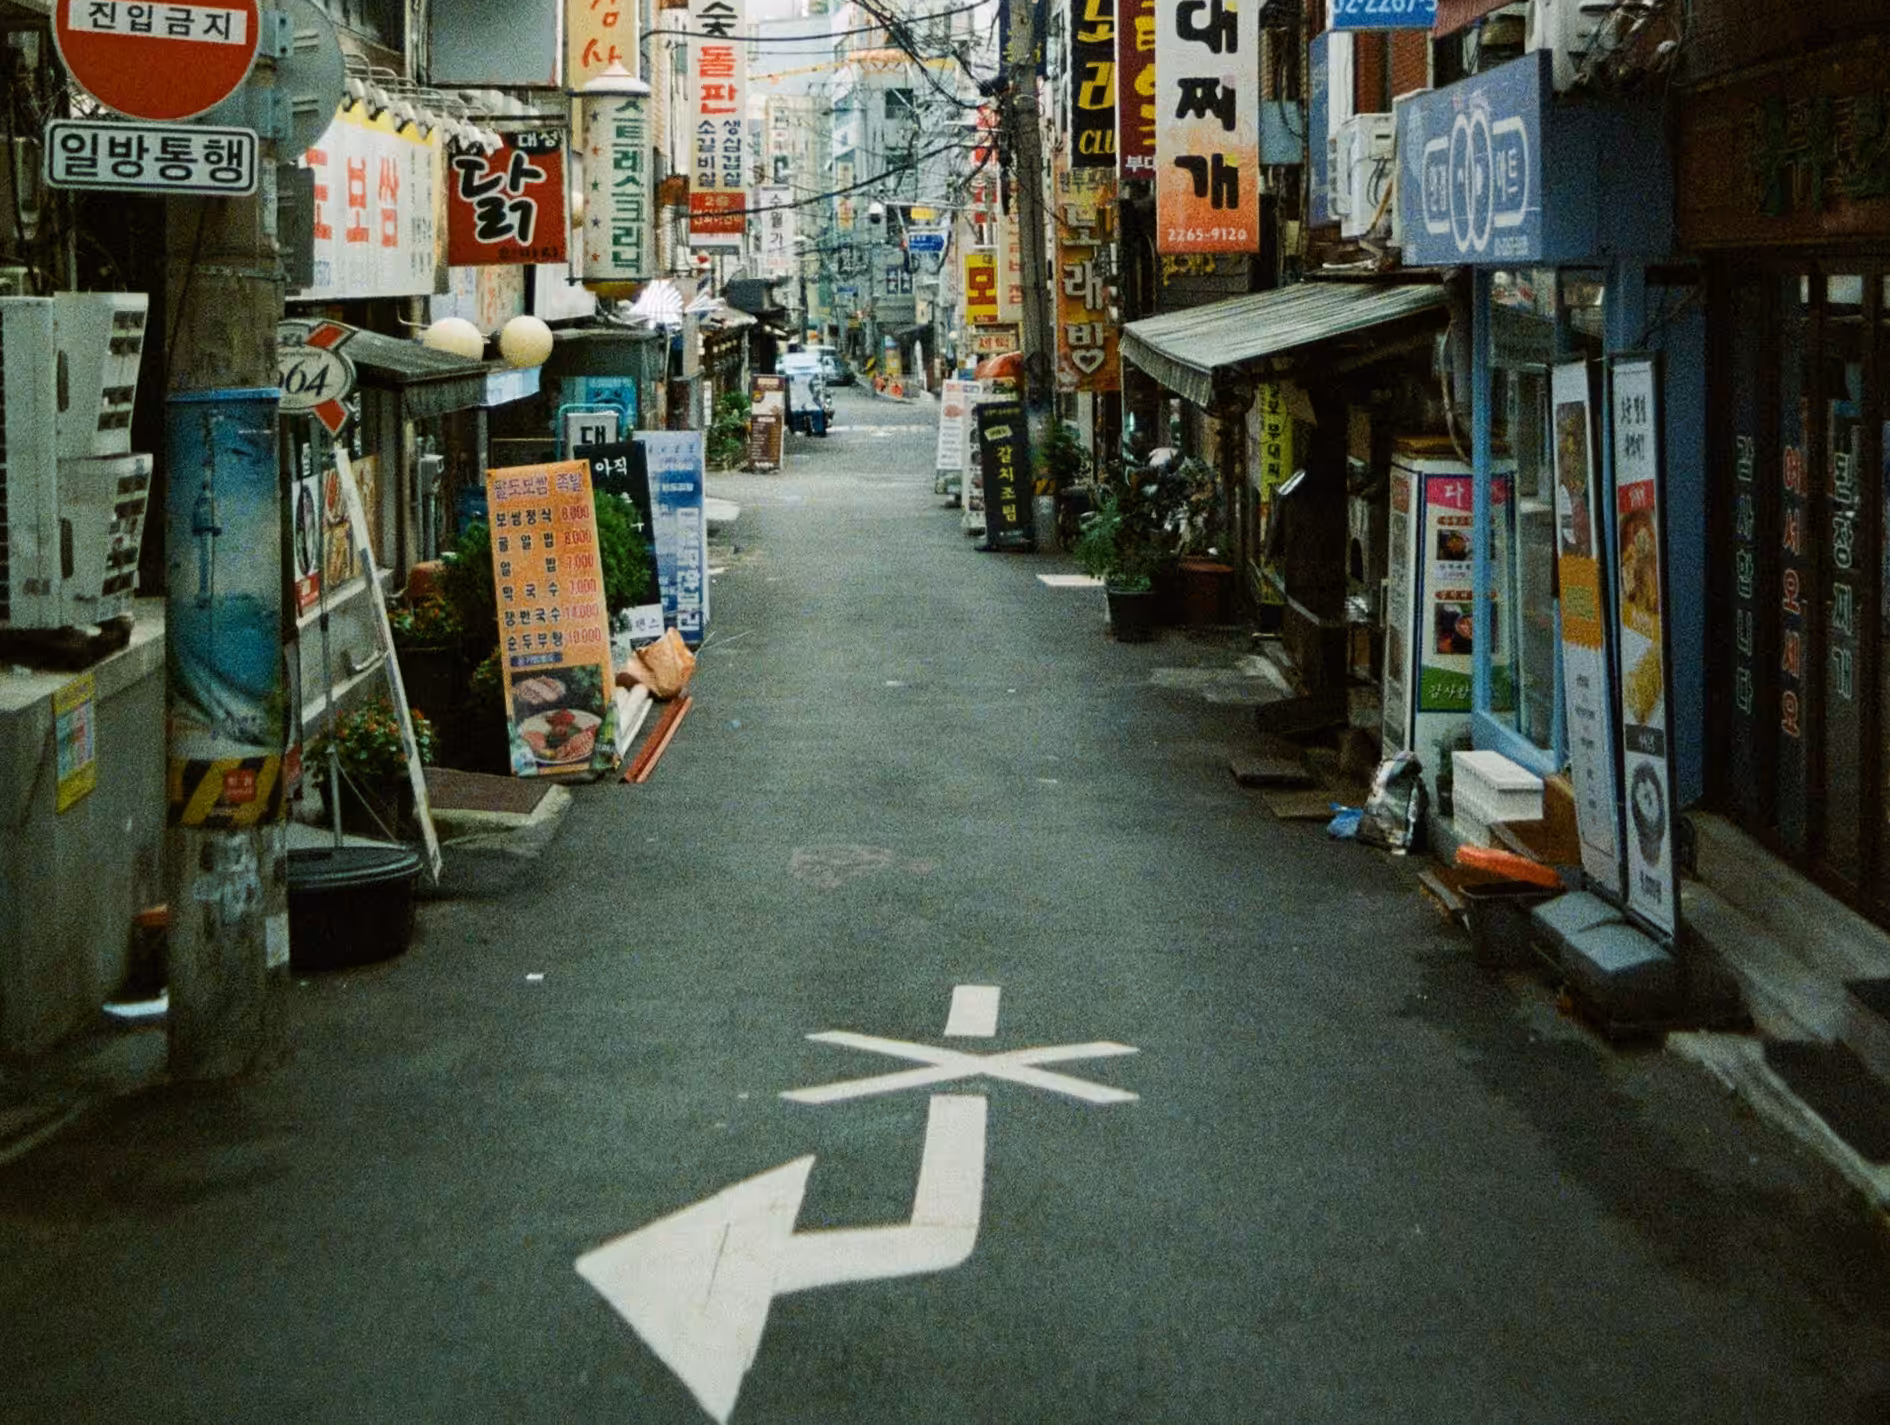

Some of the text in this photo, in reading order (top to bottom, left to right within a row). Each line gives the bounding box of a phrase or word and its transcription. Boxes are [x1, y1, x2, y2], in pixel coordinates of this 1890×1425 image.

[88, 1, 232, 41] 진입금지
[517, 131, 559, 148] 대성
[60, 132, 244, 185] 일방통행
[1167, 228, 1247, 242] 2265-9120
